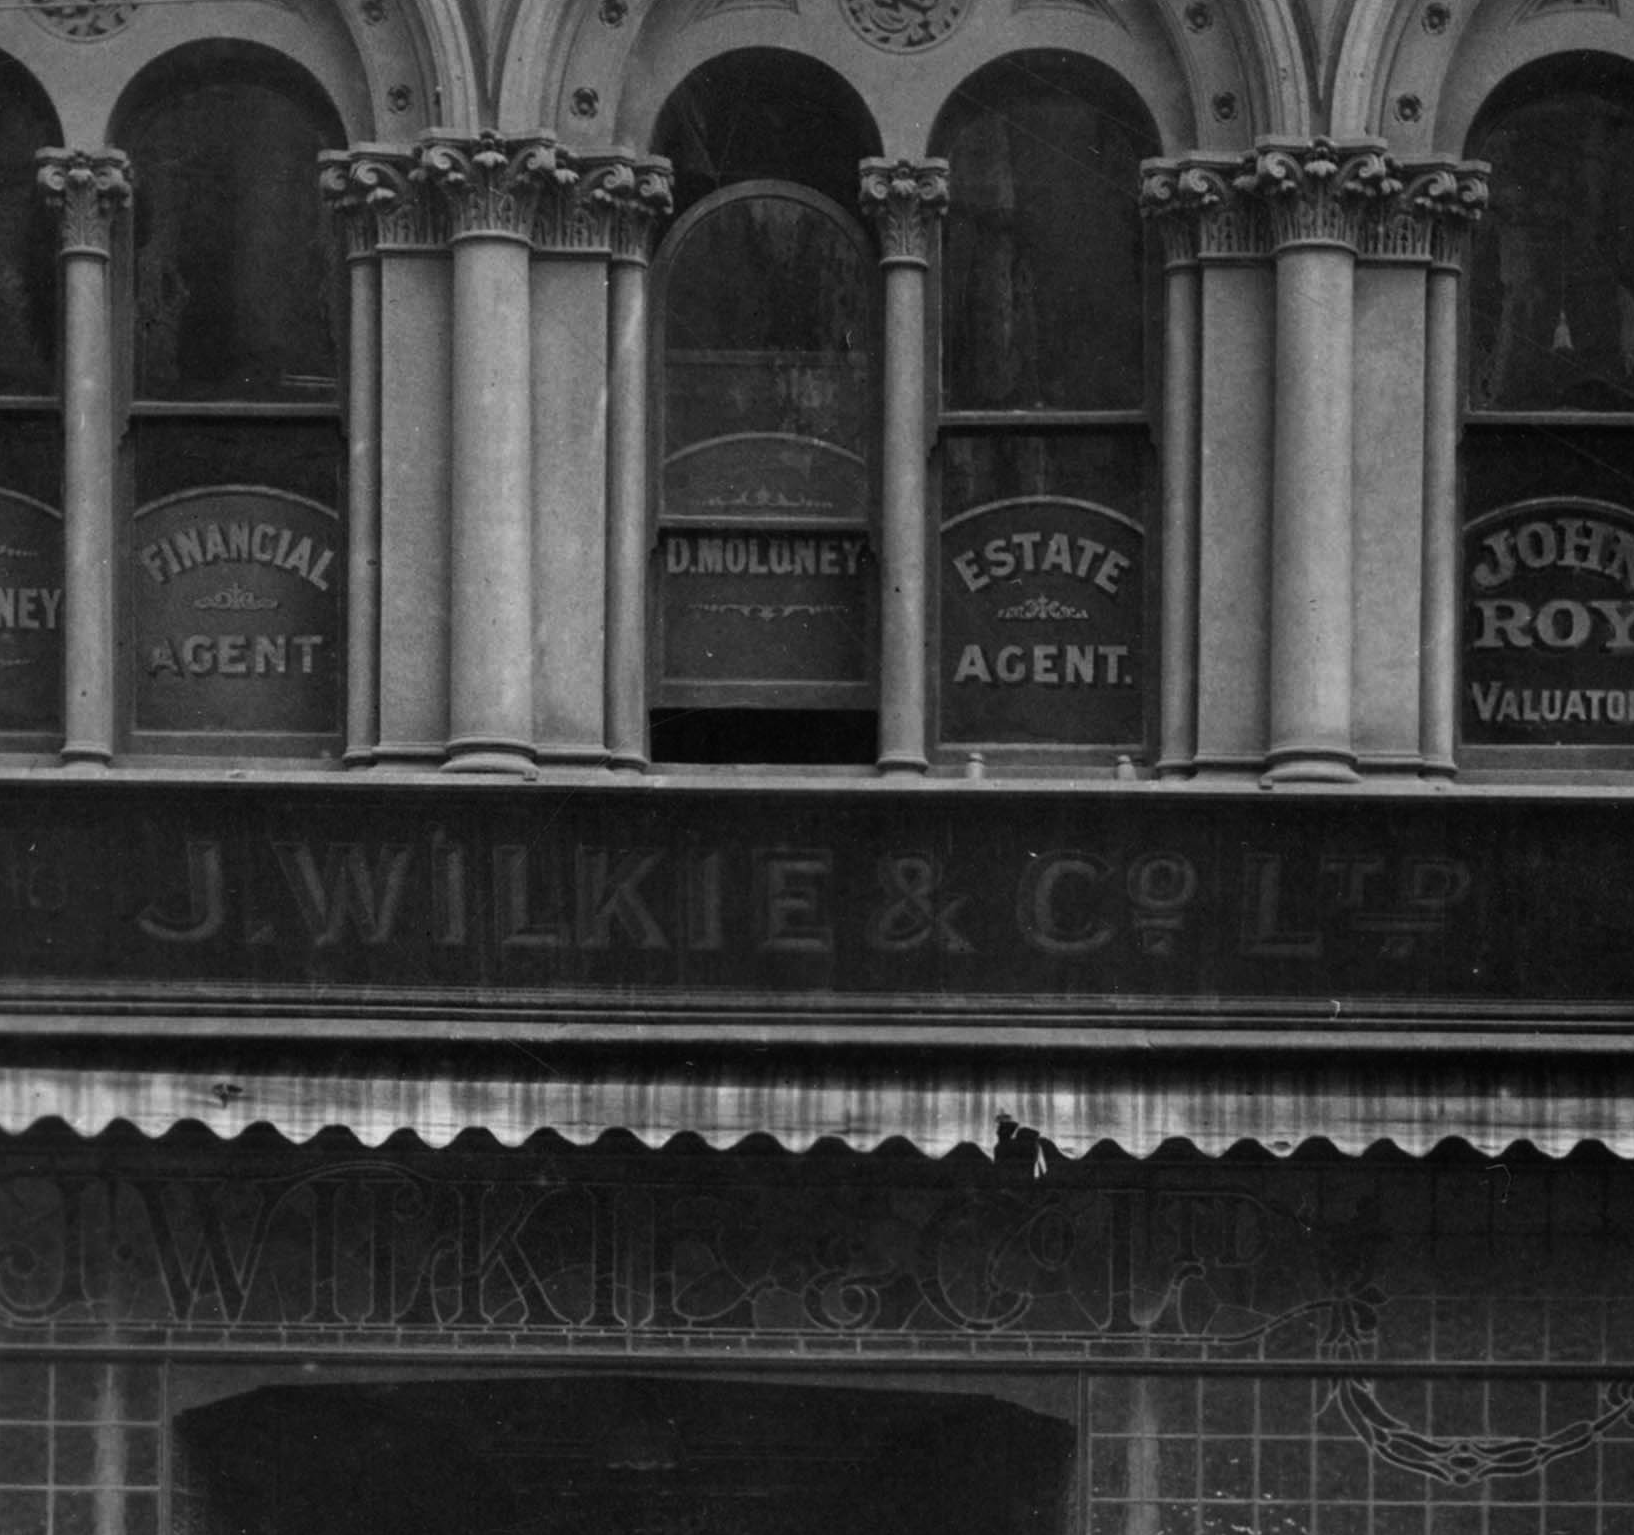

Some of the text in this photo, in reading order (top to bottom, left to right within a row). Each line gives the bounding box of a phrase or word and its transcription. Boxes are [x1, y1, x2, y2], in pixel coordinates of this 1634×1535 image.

[141, 520, 334, 592] FINANCIAL
[953, 531, 1131, 594] ESTATE
[151, 635, 323, 677] AGENT
[954, 644, 1134, 684] AGENT.
[274, 837, 834, 952] WILKIE
[869, 853, 974, 955] &
